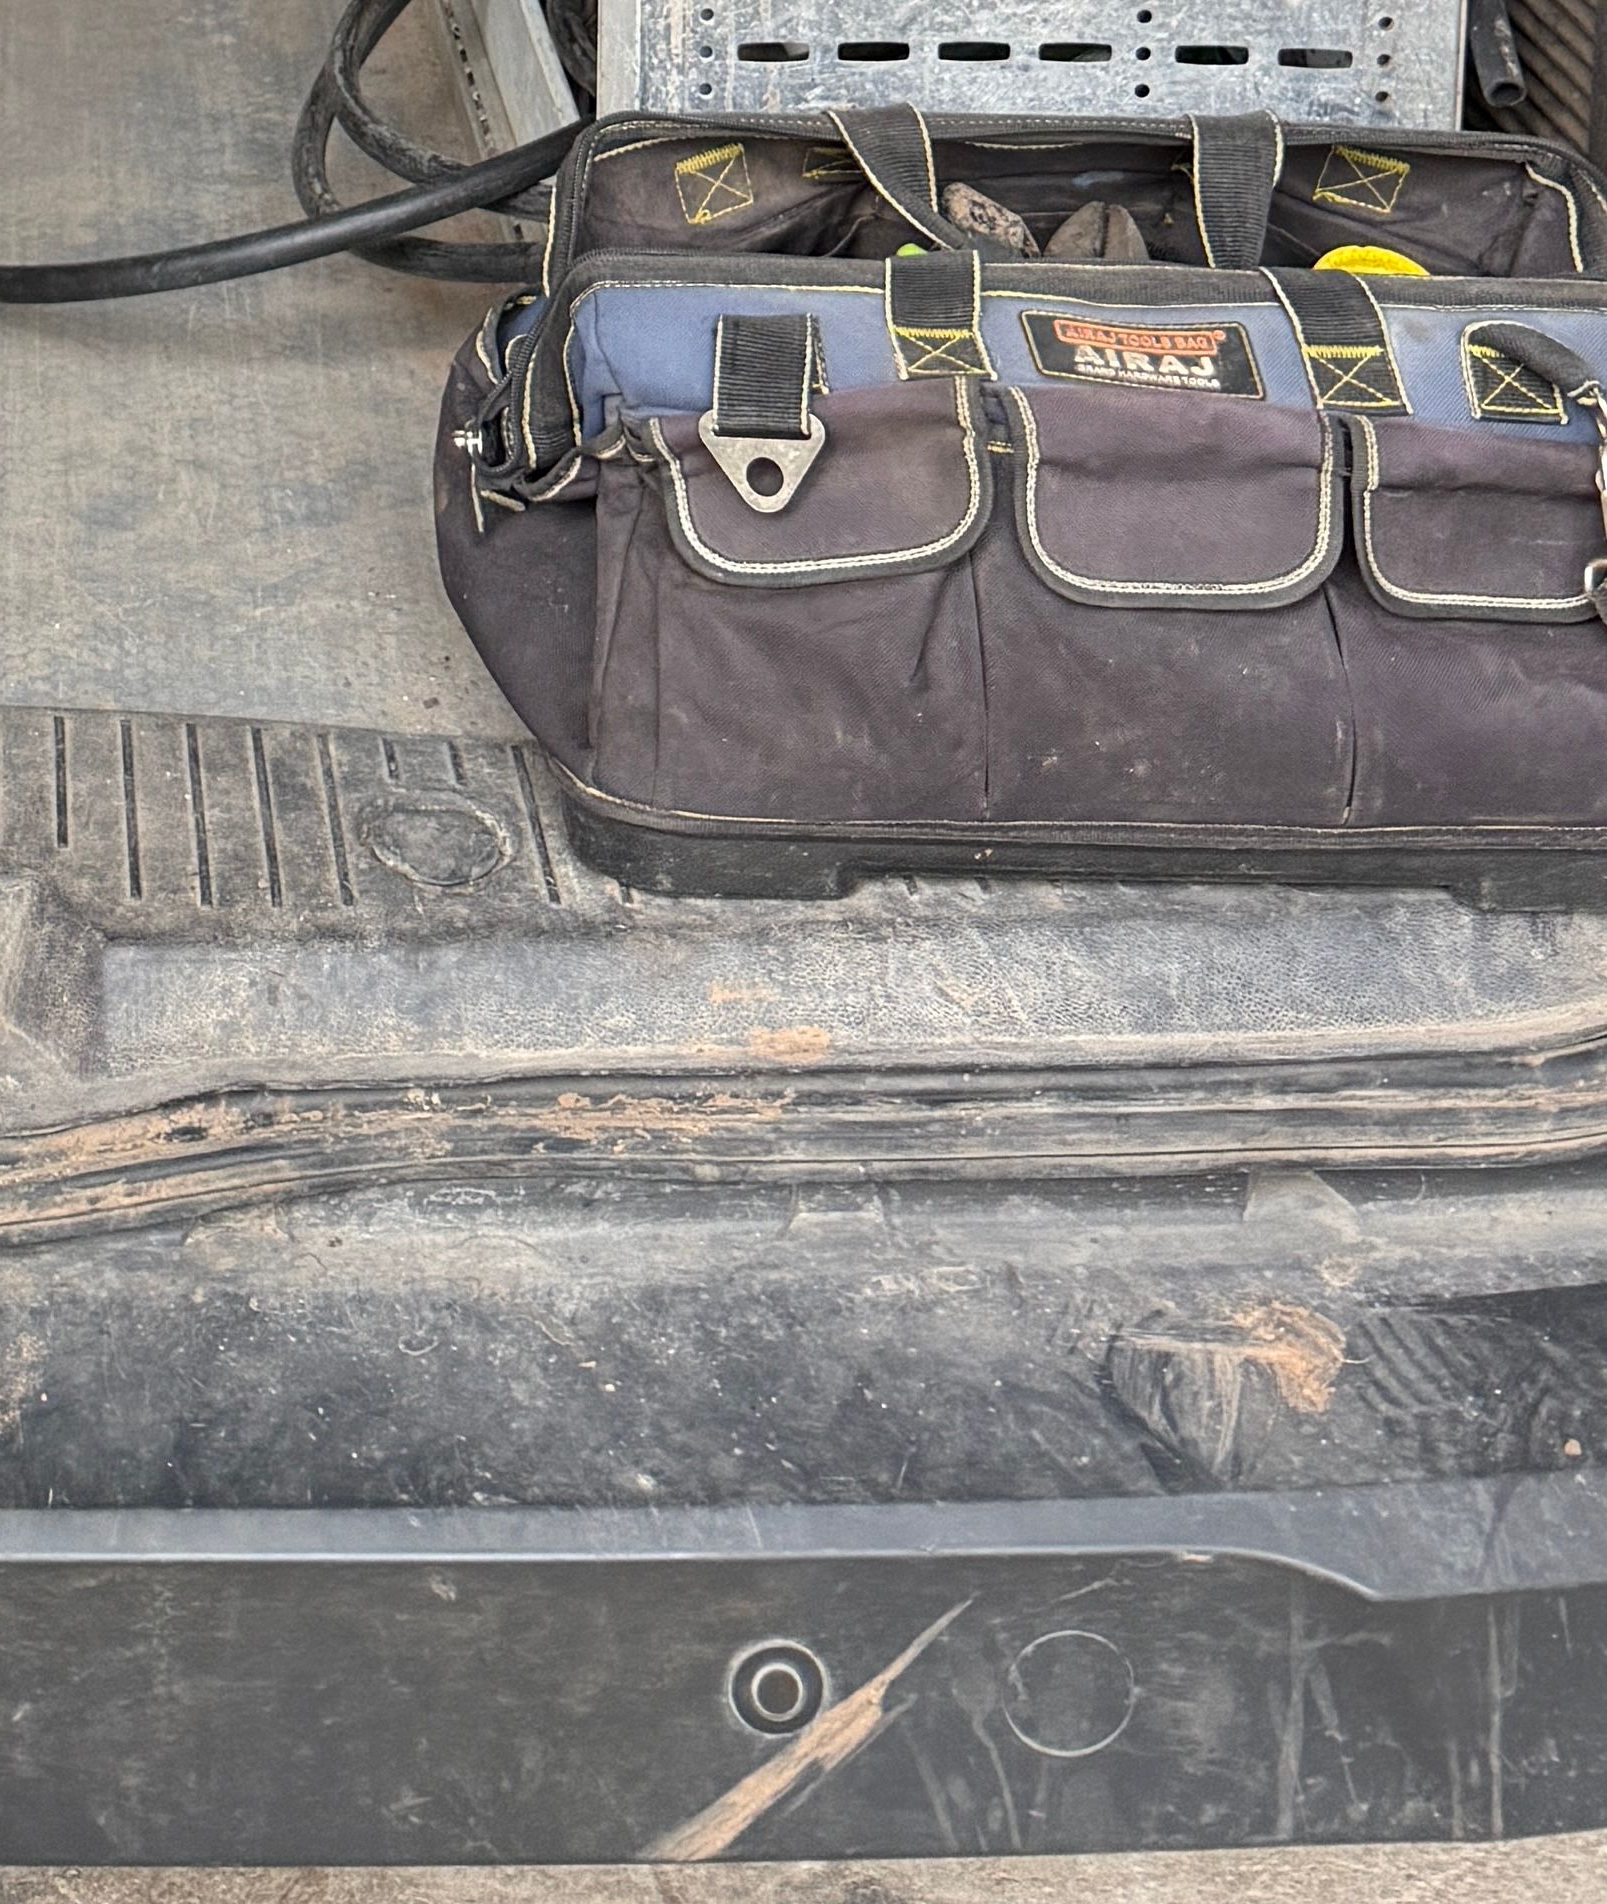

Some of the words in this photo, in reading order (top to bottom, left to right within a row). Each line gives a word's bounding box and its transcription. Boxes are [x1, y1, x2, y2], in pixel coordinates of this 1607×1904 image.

[1066, 326, 1115, 344] AIRAJ
[1118, 333, 1171, 349] TOOLS
[1174, 336, 1208, 350] BAG
[1074, 345, 1215, 377] AIRAJ
